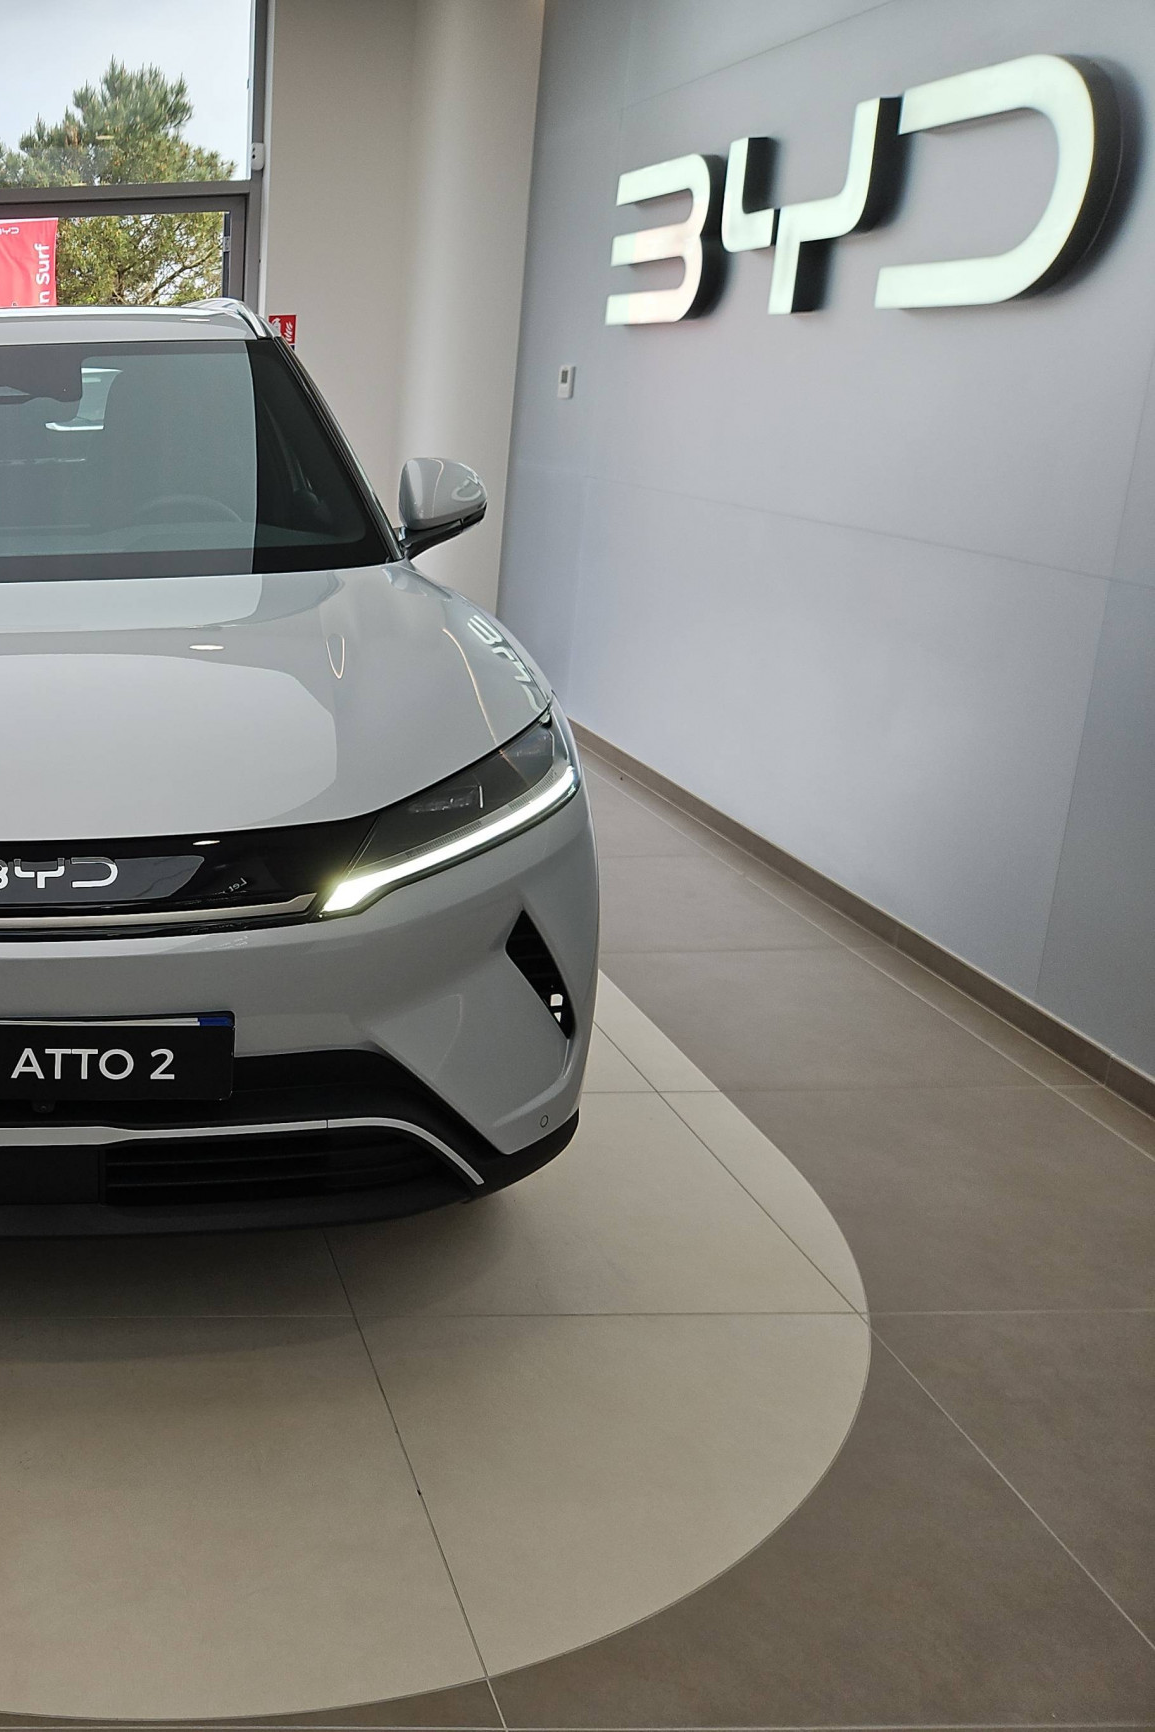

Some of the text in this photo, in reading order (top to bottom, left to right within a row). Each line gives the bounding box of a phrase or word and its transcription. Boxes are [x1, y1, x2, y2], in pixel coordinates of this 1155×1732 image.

[605, 54, 1096, 326] BYD
[34, 243, 51, 285] Surf
[10, 1047, 135, 1080] ATTO
[149, 1048, 176, 1080] 2
